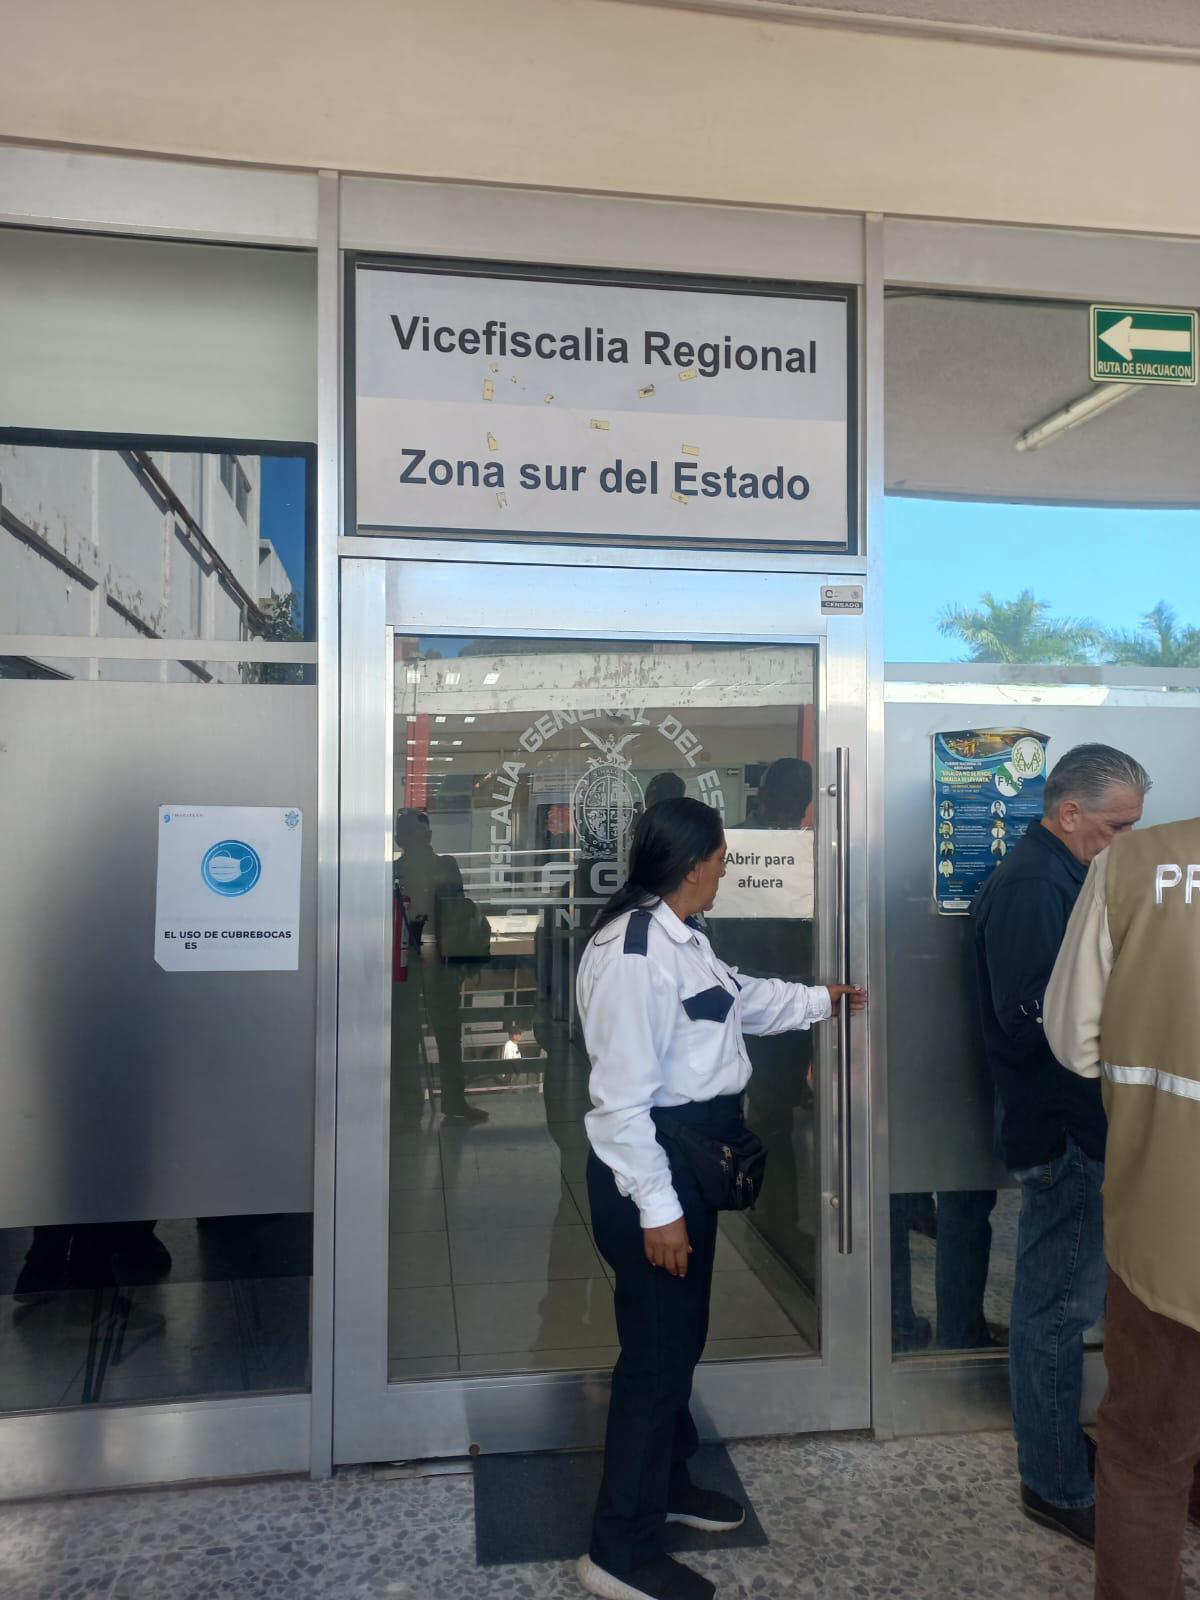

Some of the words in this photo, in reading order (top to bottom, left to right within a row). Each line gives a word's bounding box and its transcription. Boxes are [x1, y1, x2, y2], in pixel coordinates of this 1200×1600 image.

[390, 314, 628, 363] Vicefiscalia
[644, 331, 816, 378] Regional
[1098, 361, 1121, 373] RUTA
[1122, 362, 1134, 374] DE
[1136, 363, 1191, 377] EVACUACION
[400, 448, 504, 489] Zona
[520, 463, 586, 492] sur
[600, 459, 658, 495] del
[674, 461, 810, 501] Estado
[657, 714, 704, 768] DEL
[725, 852, 761, 865] Abrir
[765, 856, 795, 868] para
[738, 875, 783, 888] afuera
[164, 931, 177, 939] EL
[179, 931, 201, 939] USO
[204, 931, 219, 939] DE
[221, 931, 292, 939] CUBREBOCAS
[185, 942, 197, 950] ES
